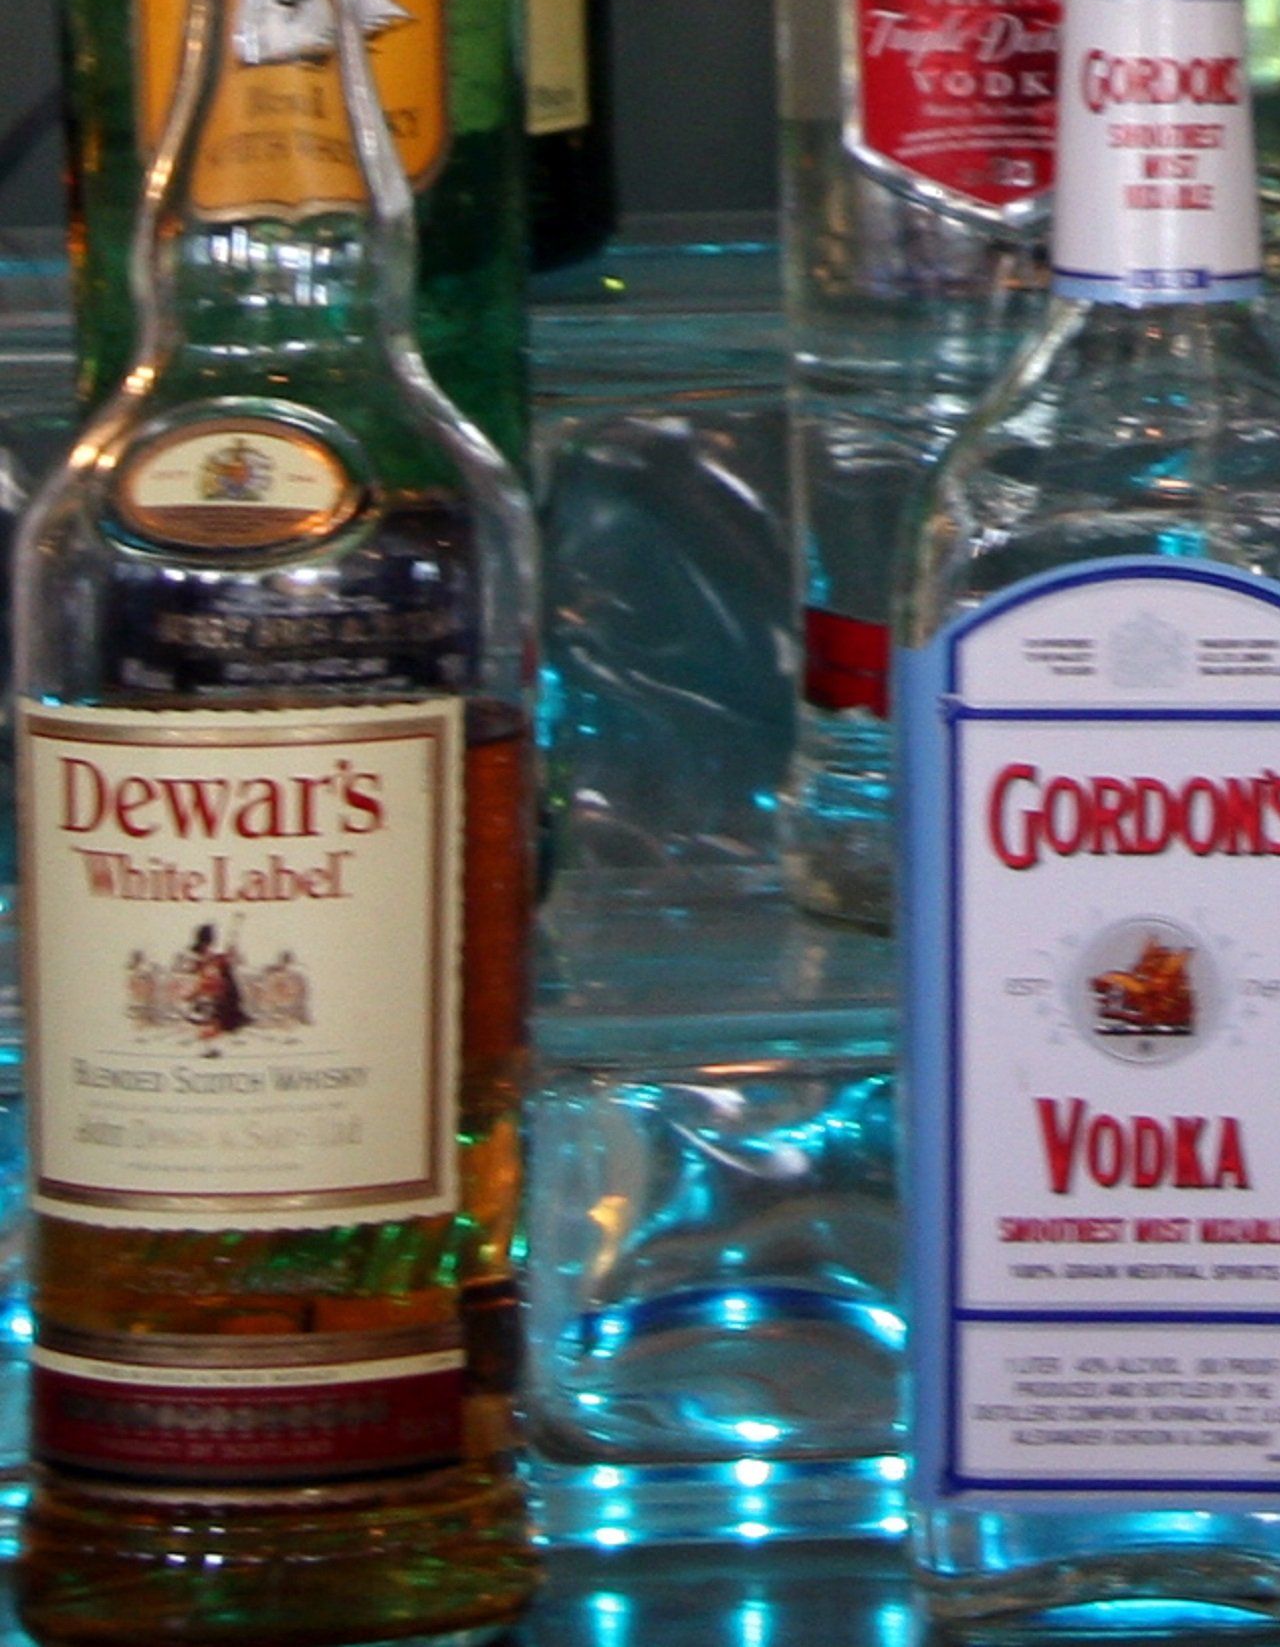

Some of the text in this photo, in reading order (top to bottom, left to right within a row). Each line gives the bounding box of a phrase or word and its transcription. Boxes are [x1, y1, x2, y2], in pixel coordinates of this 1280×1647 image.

[59, 748, 385, 839] Dewar's
[70, 846, 354, 903] White Label
[1034, 1096, 1253, 1196] VODKA
